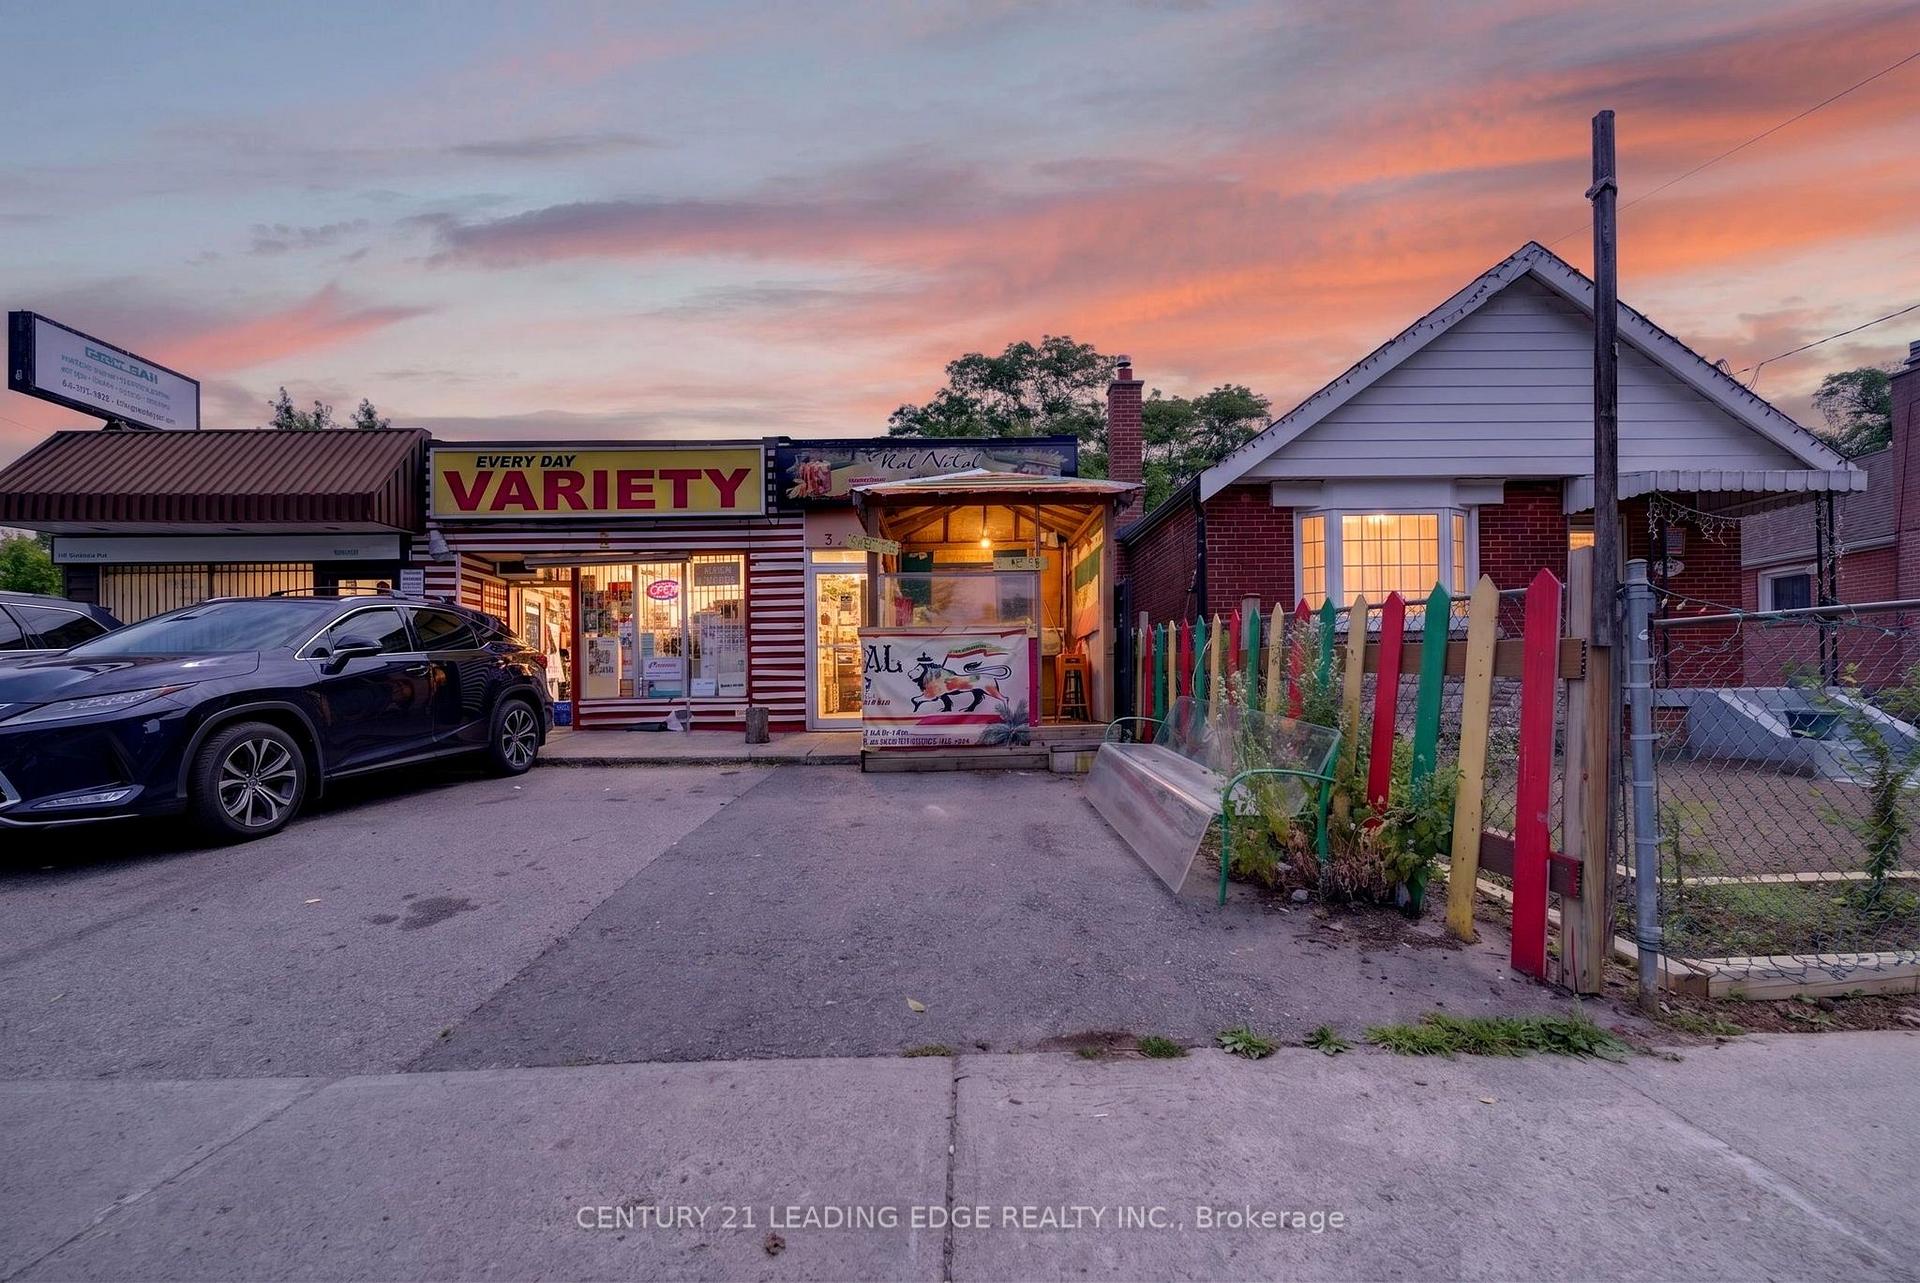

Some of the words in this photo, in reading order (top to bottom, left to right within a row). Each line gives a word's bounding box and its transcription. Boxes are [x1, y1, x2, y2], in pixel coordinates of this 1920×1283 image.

[476, 455, 536, 468] EVERY
[540, 455, 577, 468] DAY
[443, 468, 752, 511] VARIETY
